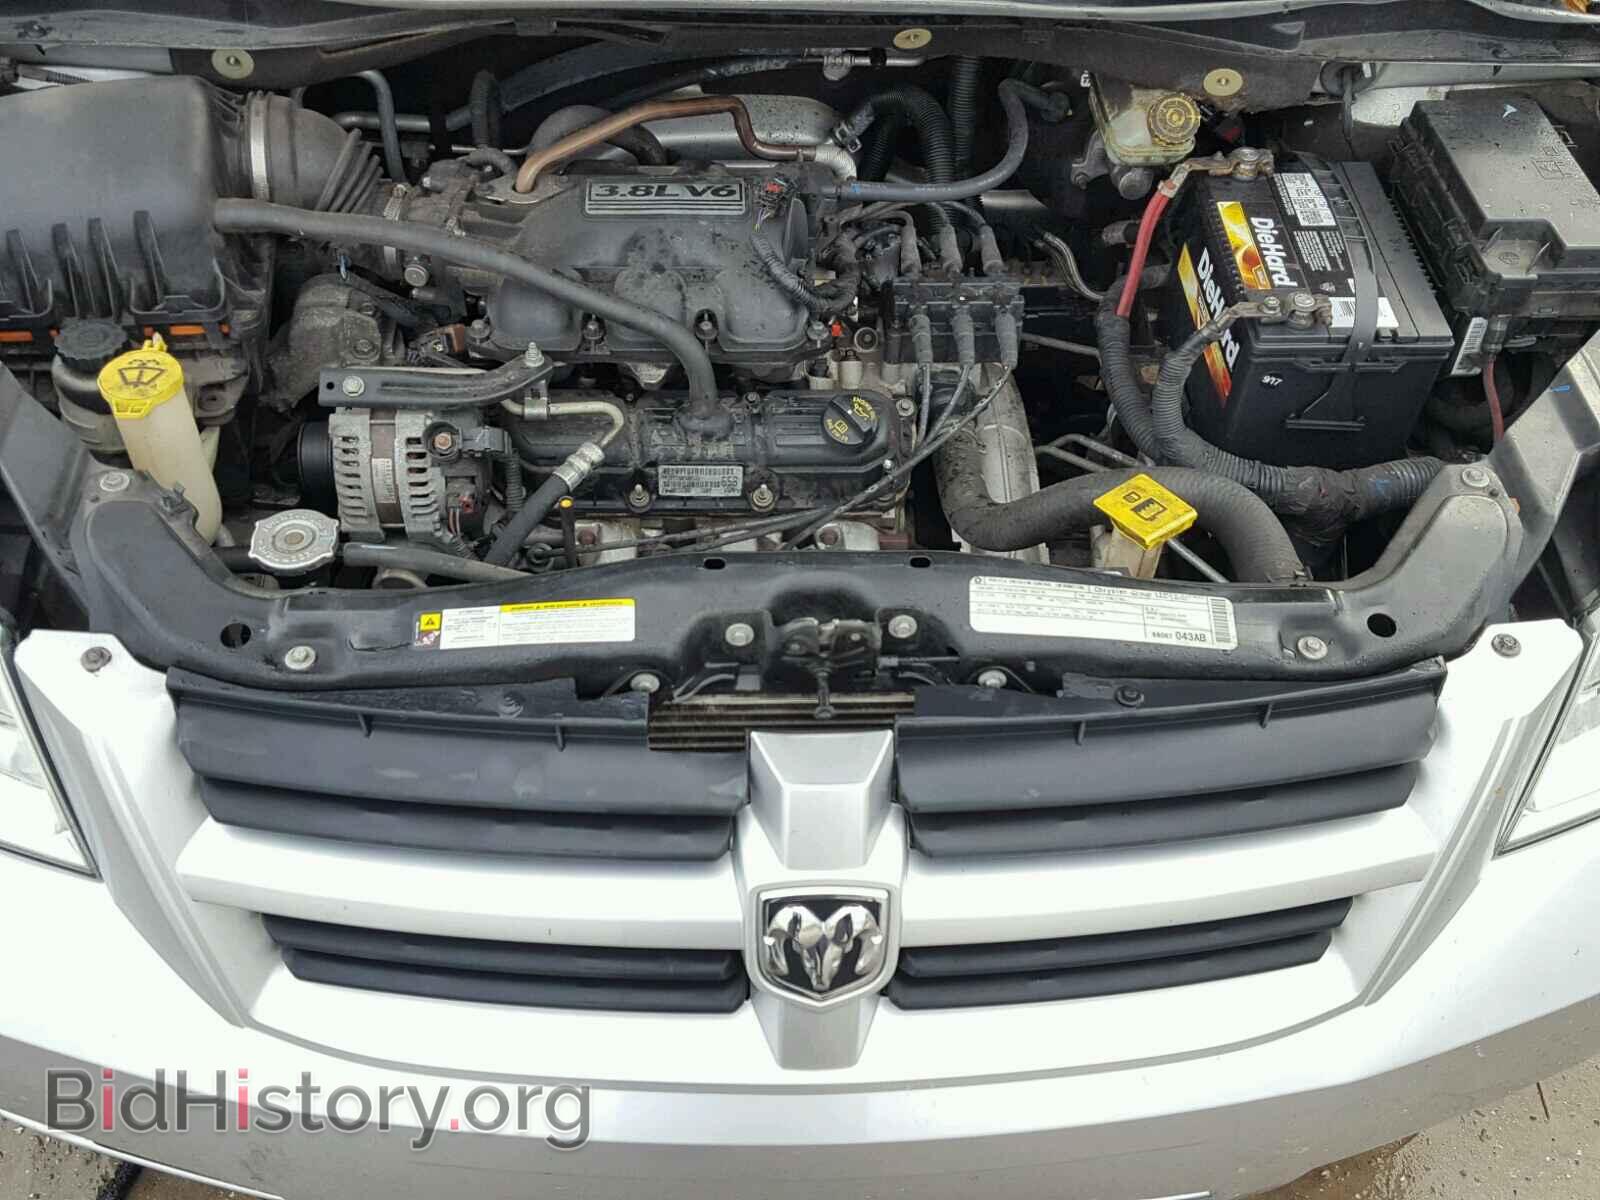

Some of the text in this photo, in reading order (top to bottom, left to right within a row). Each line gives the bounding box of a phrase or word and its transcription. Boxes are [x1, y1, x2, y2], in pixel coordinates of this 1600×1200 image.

[595, 184, 737, 198] 3.8L V6
[1250, 217, 1298, 288] DieHard
[1197, 246, 1240, 373] DieHrd
[1174, 631, 1207, 642] 043AB
